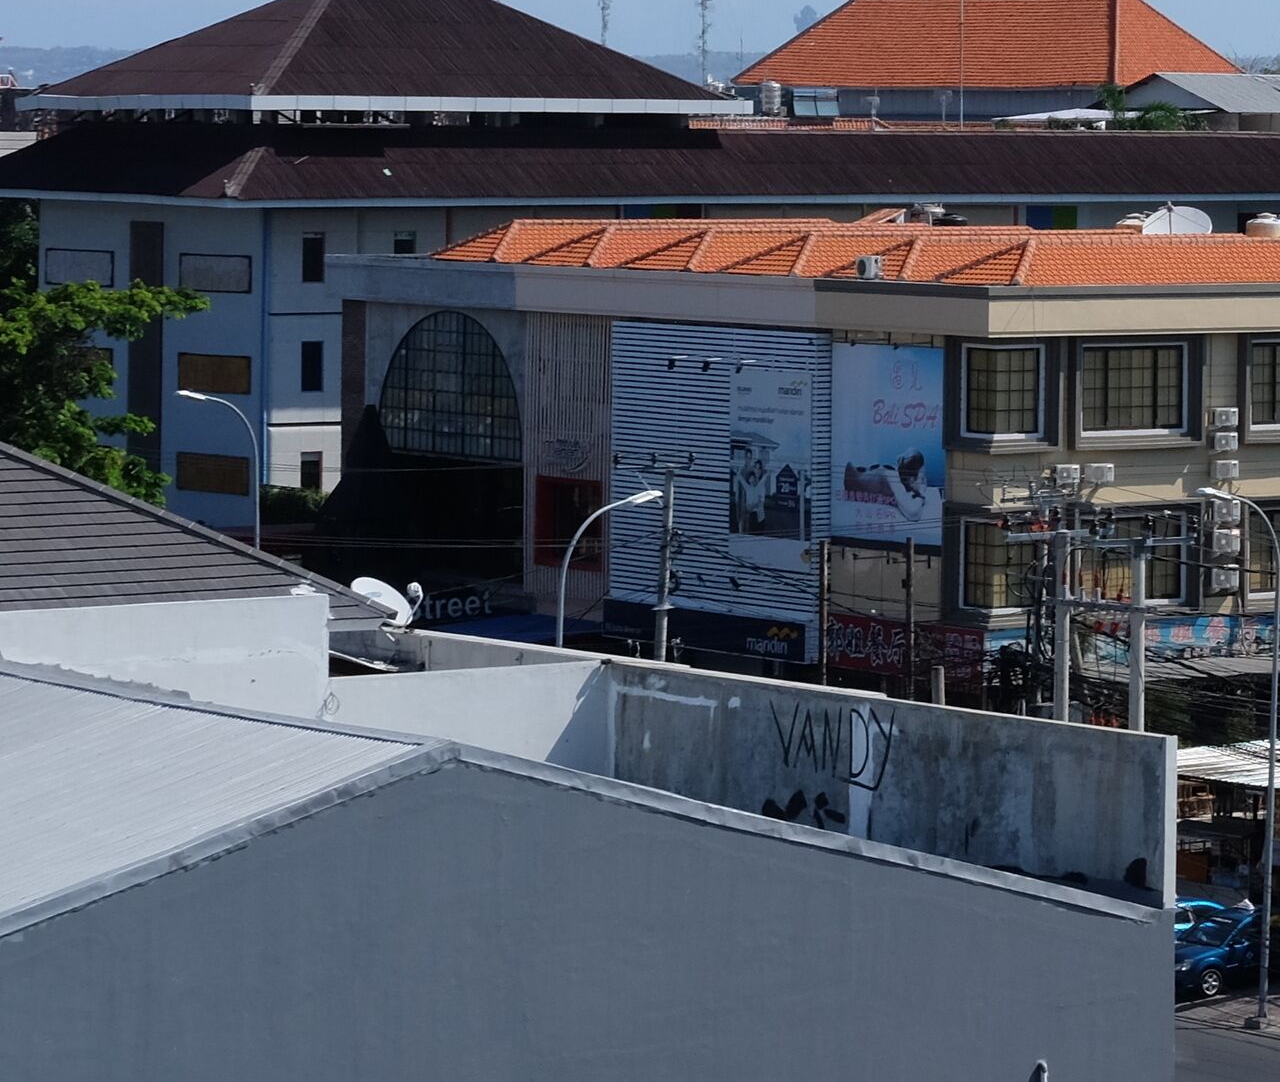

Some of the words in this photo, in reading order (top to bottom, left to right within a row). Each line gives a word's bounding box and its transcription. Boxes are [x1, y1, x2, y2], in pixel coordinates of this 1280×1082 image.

[873, 399, 898, 425] Bali
[900, 402, 940, 429] SPA
[769, 699, 896, 791] VANDY
